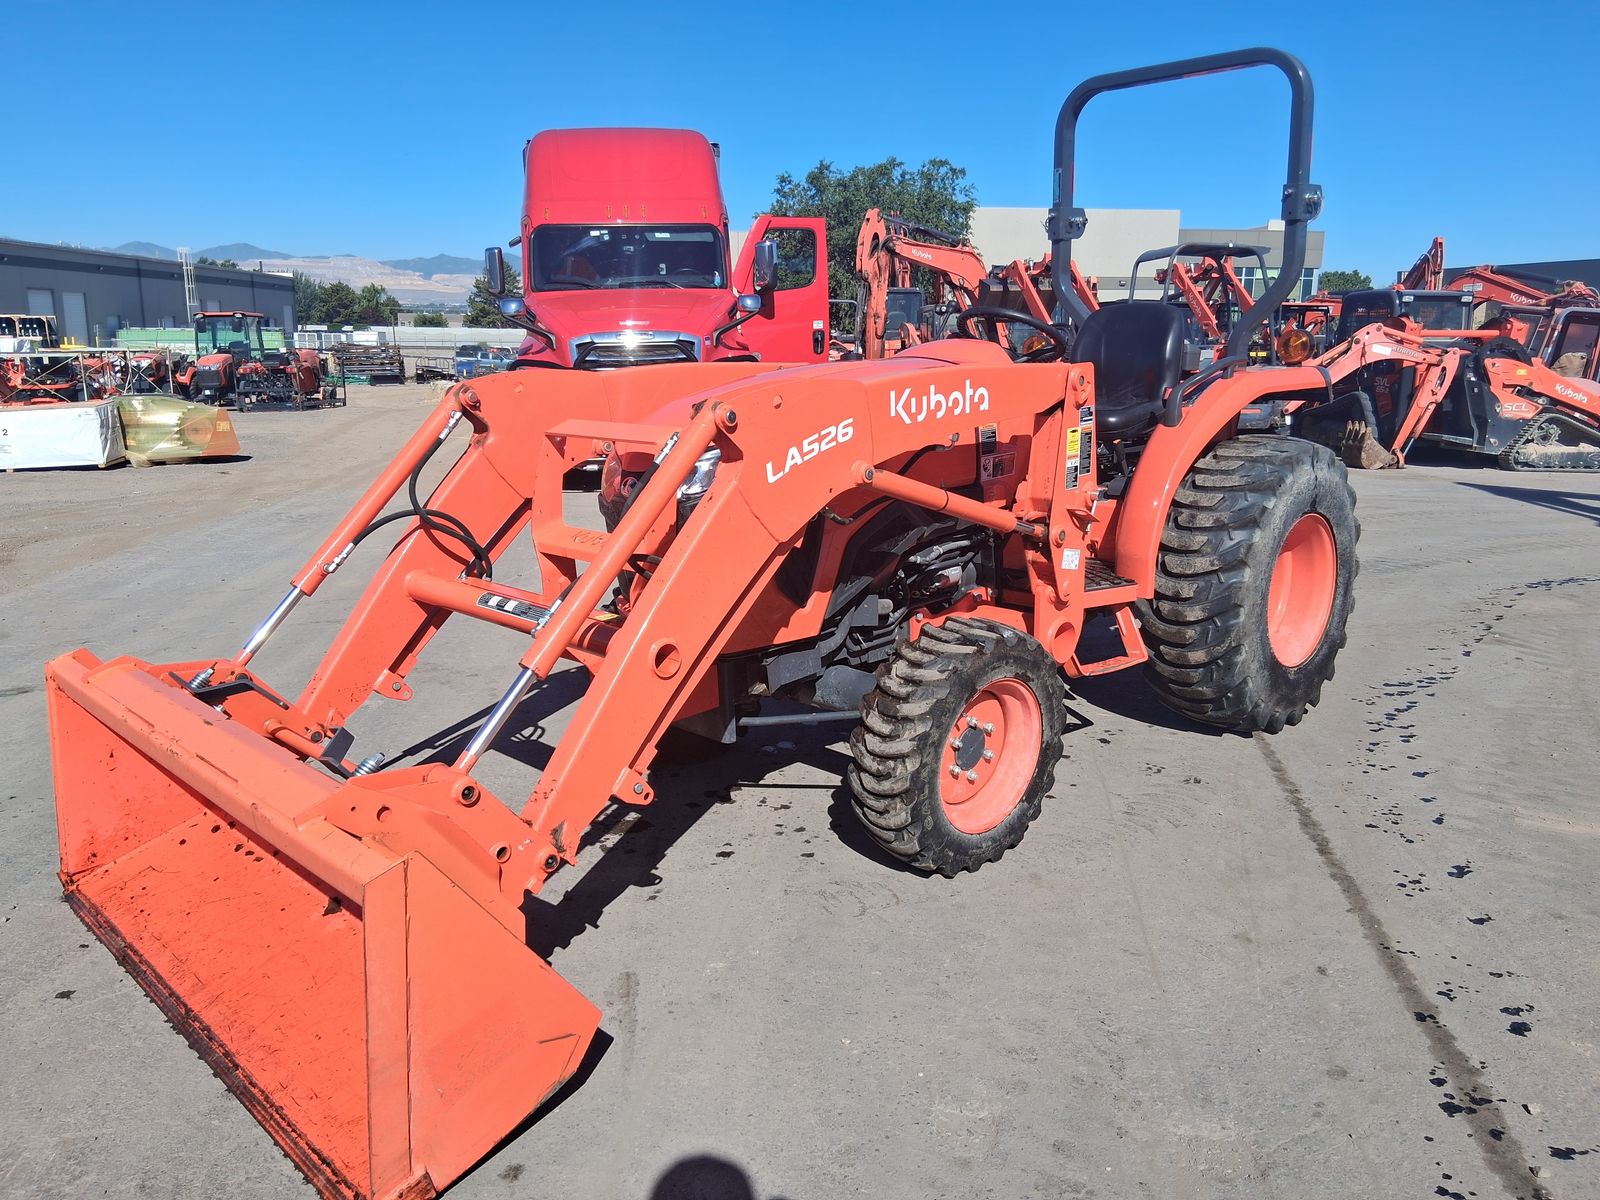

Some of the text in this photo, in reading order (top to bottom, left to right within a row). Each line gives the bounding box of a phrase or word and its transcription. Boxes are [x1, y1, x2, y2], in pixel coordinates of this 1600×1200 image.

[911, 247, 932, 260] Kubota
[1375, 376, 1390, 387] SVL
[889, 379, 989, 424] Kubota
[1555, 383, 1588, 404] Kubota
[1502, 402, 1529, 411] SCL
[765, 417, 854, 484] LA526
